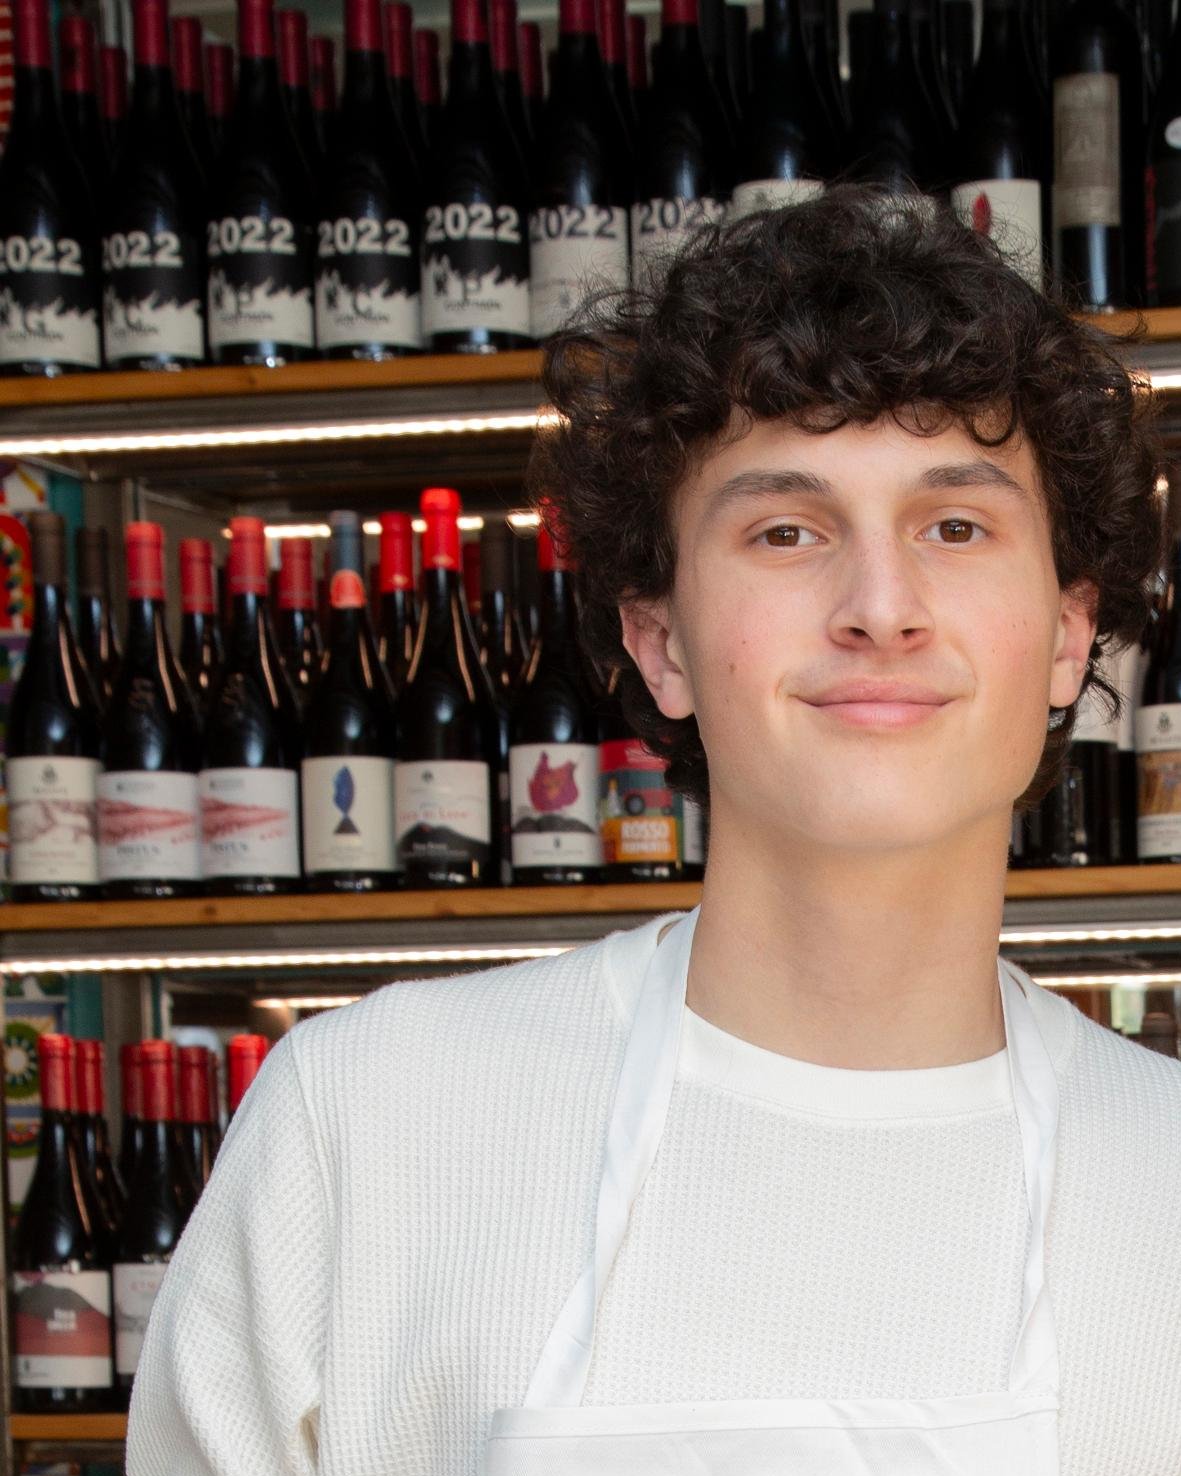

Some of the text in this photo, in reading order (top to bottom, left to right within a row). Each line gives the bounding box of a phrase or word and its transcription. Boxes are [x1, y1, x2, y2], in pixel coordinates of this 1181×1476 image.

[207, 216, 296, 256] 2022
[318, 217, 411, 256] 2022
[425, 201, 520, 243] 2022
